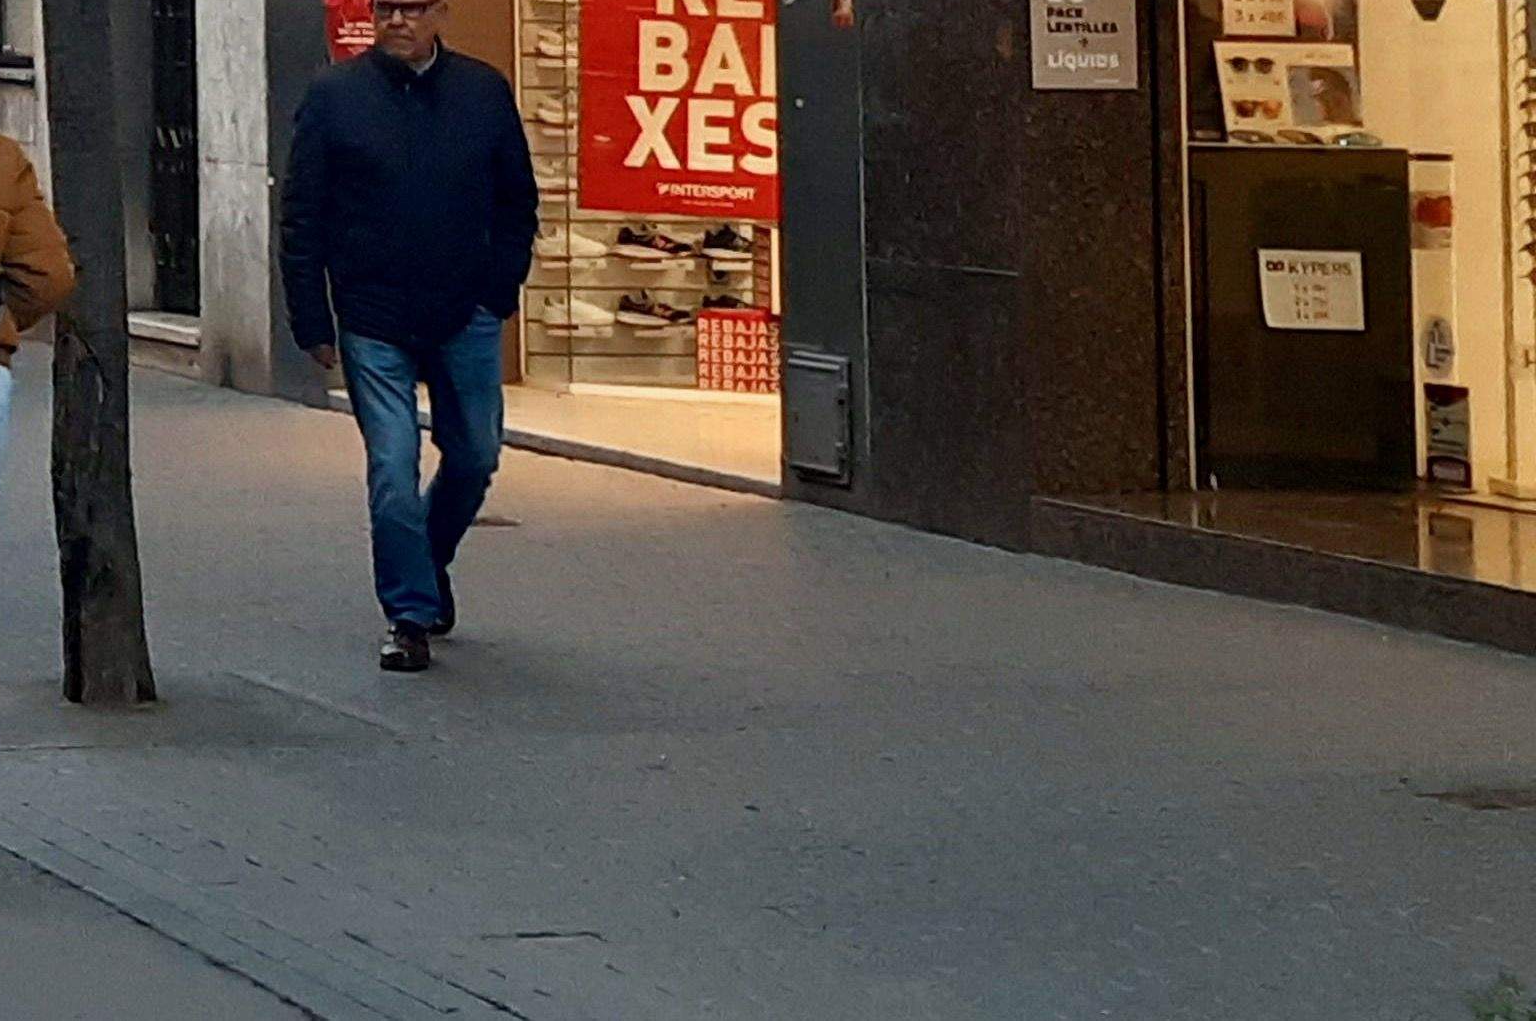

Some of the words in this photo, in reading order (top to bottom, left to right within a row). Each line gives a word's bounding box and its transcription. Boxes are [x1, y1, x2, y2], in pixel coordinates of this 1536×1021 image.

[1046, 6, 1084, 18] PACK
[638, 19, 777, 97] BAI
[624, 95, 778, 175] XES
[670, 183, 755, 201] INTERSPORT
[697, 318, 779, 335] REBAJAS
[697, 332, 780, 350] REBAJAS
[697, 348, 780, 366] REBAJAS
[698, 363, 781, 381] REBAJAS
